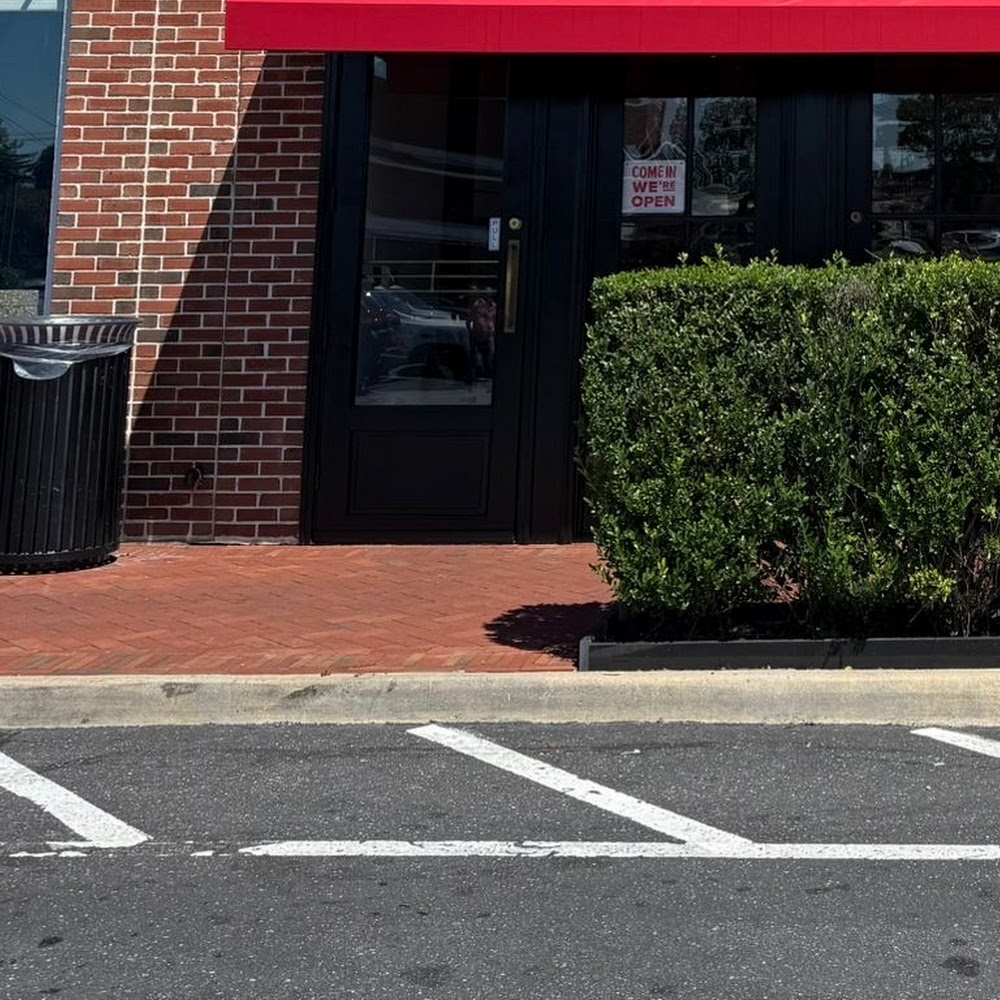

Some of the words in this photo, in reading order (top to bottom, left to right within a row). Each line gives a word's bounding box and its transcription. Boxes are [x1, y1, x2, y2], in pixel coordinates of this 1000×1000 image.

[632, 165, 664, 179] COME
[665, 165, 677, 179] IN
[632, 180, 676, 193] WE'RE
[631, 195, 676, 208] OPEN
